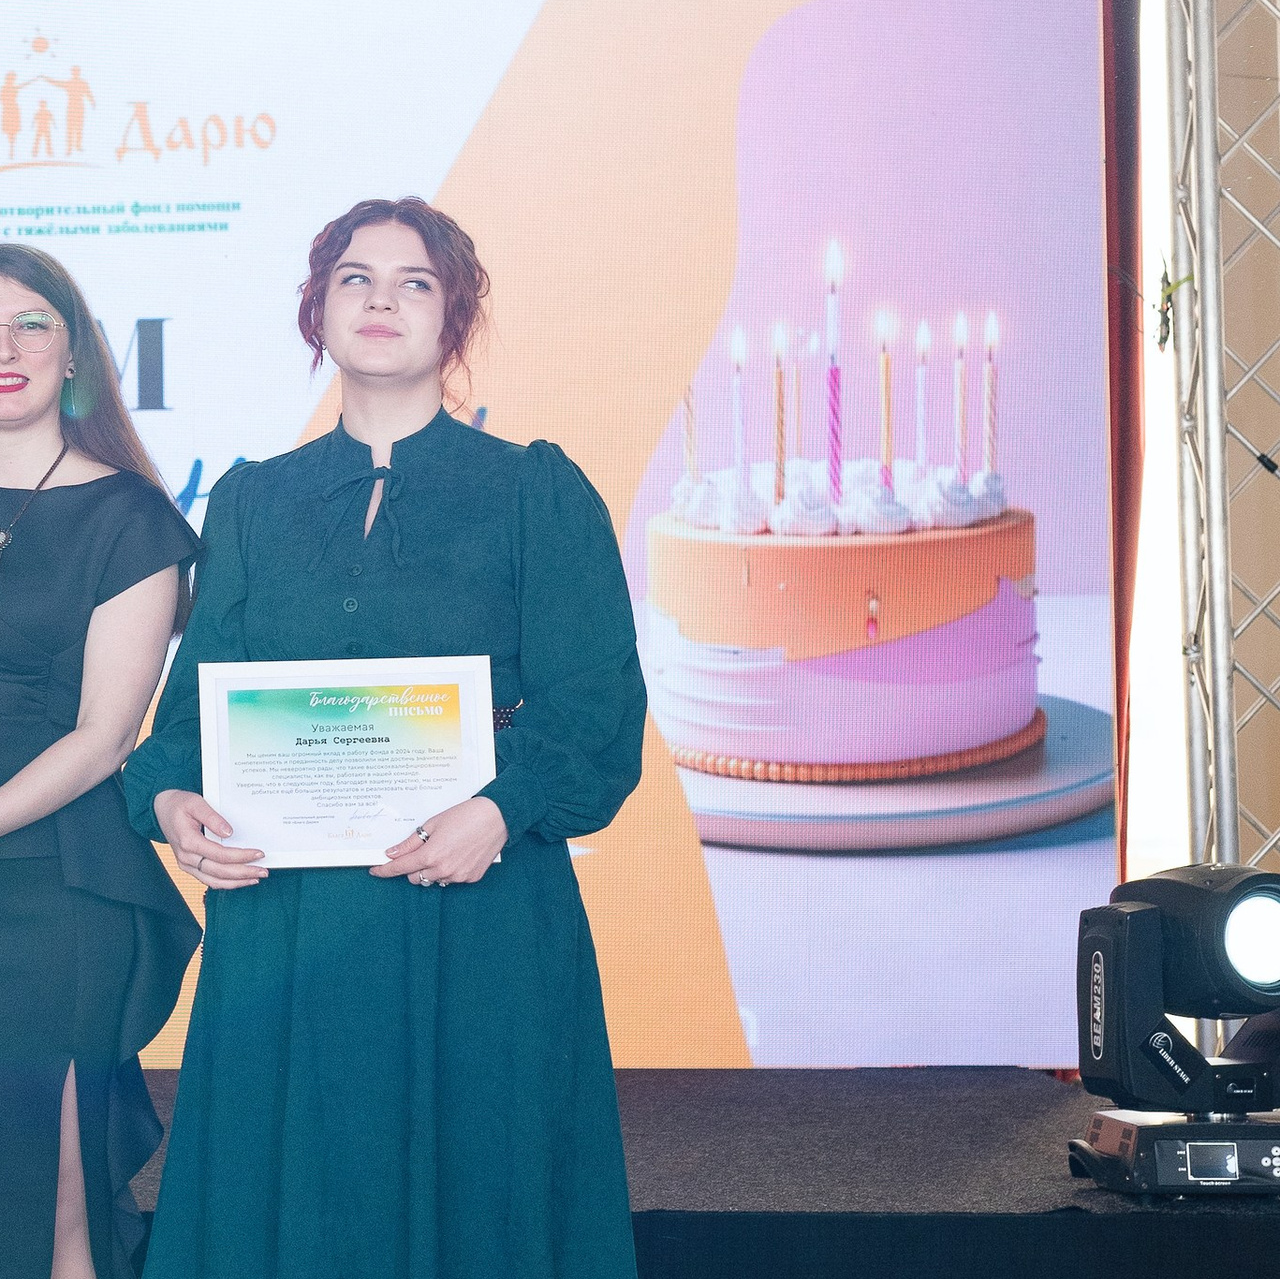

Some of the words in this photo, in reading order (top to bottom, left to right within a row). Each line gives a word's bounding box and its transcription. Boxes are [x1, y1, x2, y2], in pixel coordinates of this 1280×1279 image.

[115, 101, 277, 166] Дарю
[131, 200, 170, 217] фонд
[176, 202, 241, 214] помощи
[3, 228, 10, 236] с
[17, 222, 100, 236] тяжёлыми
[108, 221, 229, 234] заболеваниями
[309, 686, 450, 713] Благодарственное
[312, 724, 374, 732] Уважаемая
[296, 738, 327, 746] Дарья
[333, 736, 390, 746] Сергеевна
[1093, 962, 1102, 1047] BEAM230
